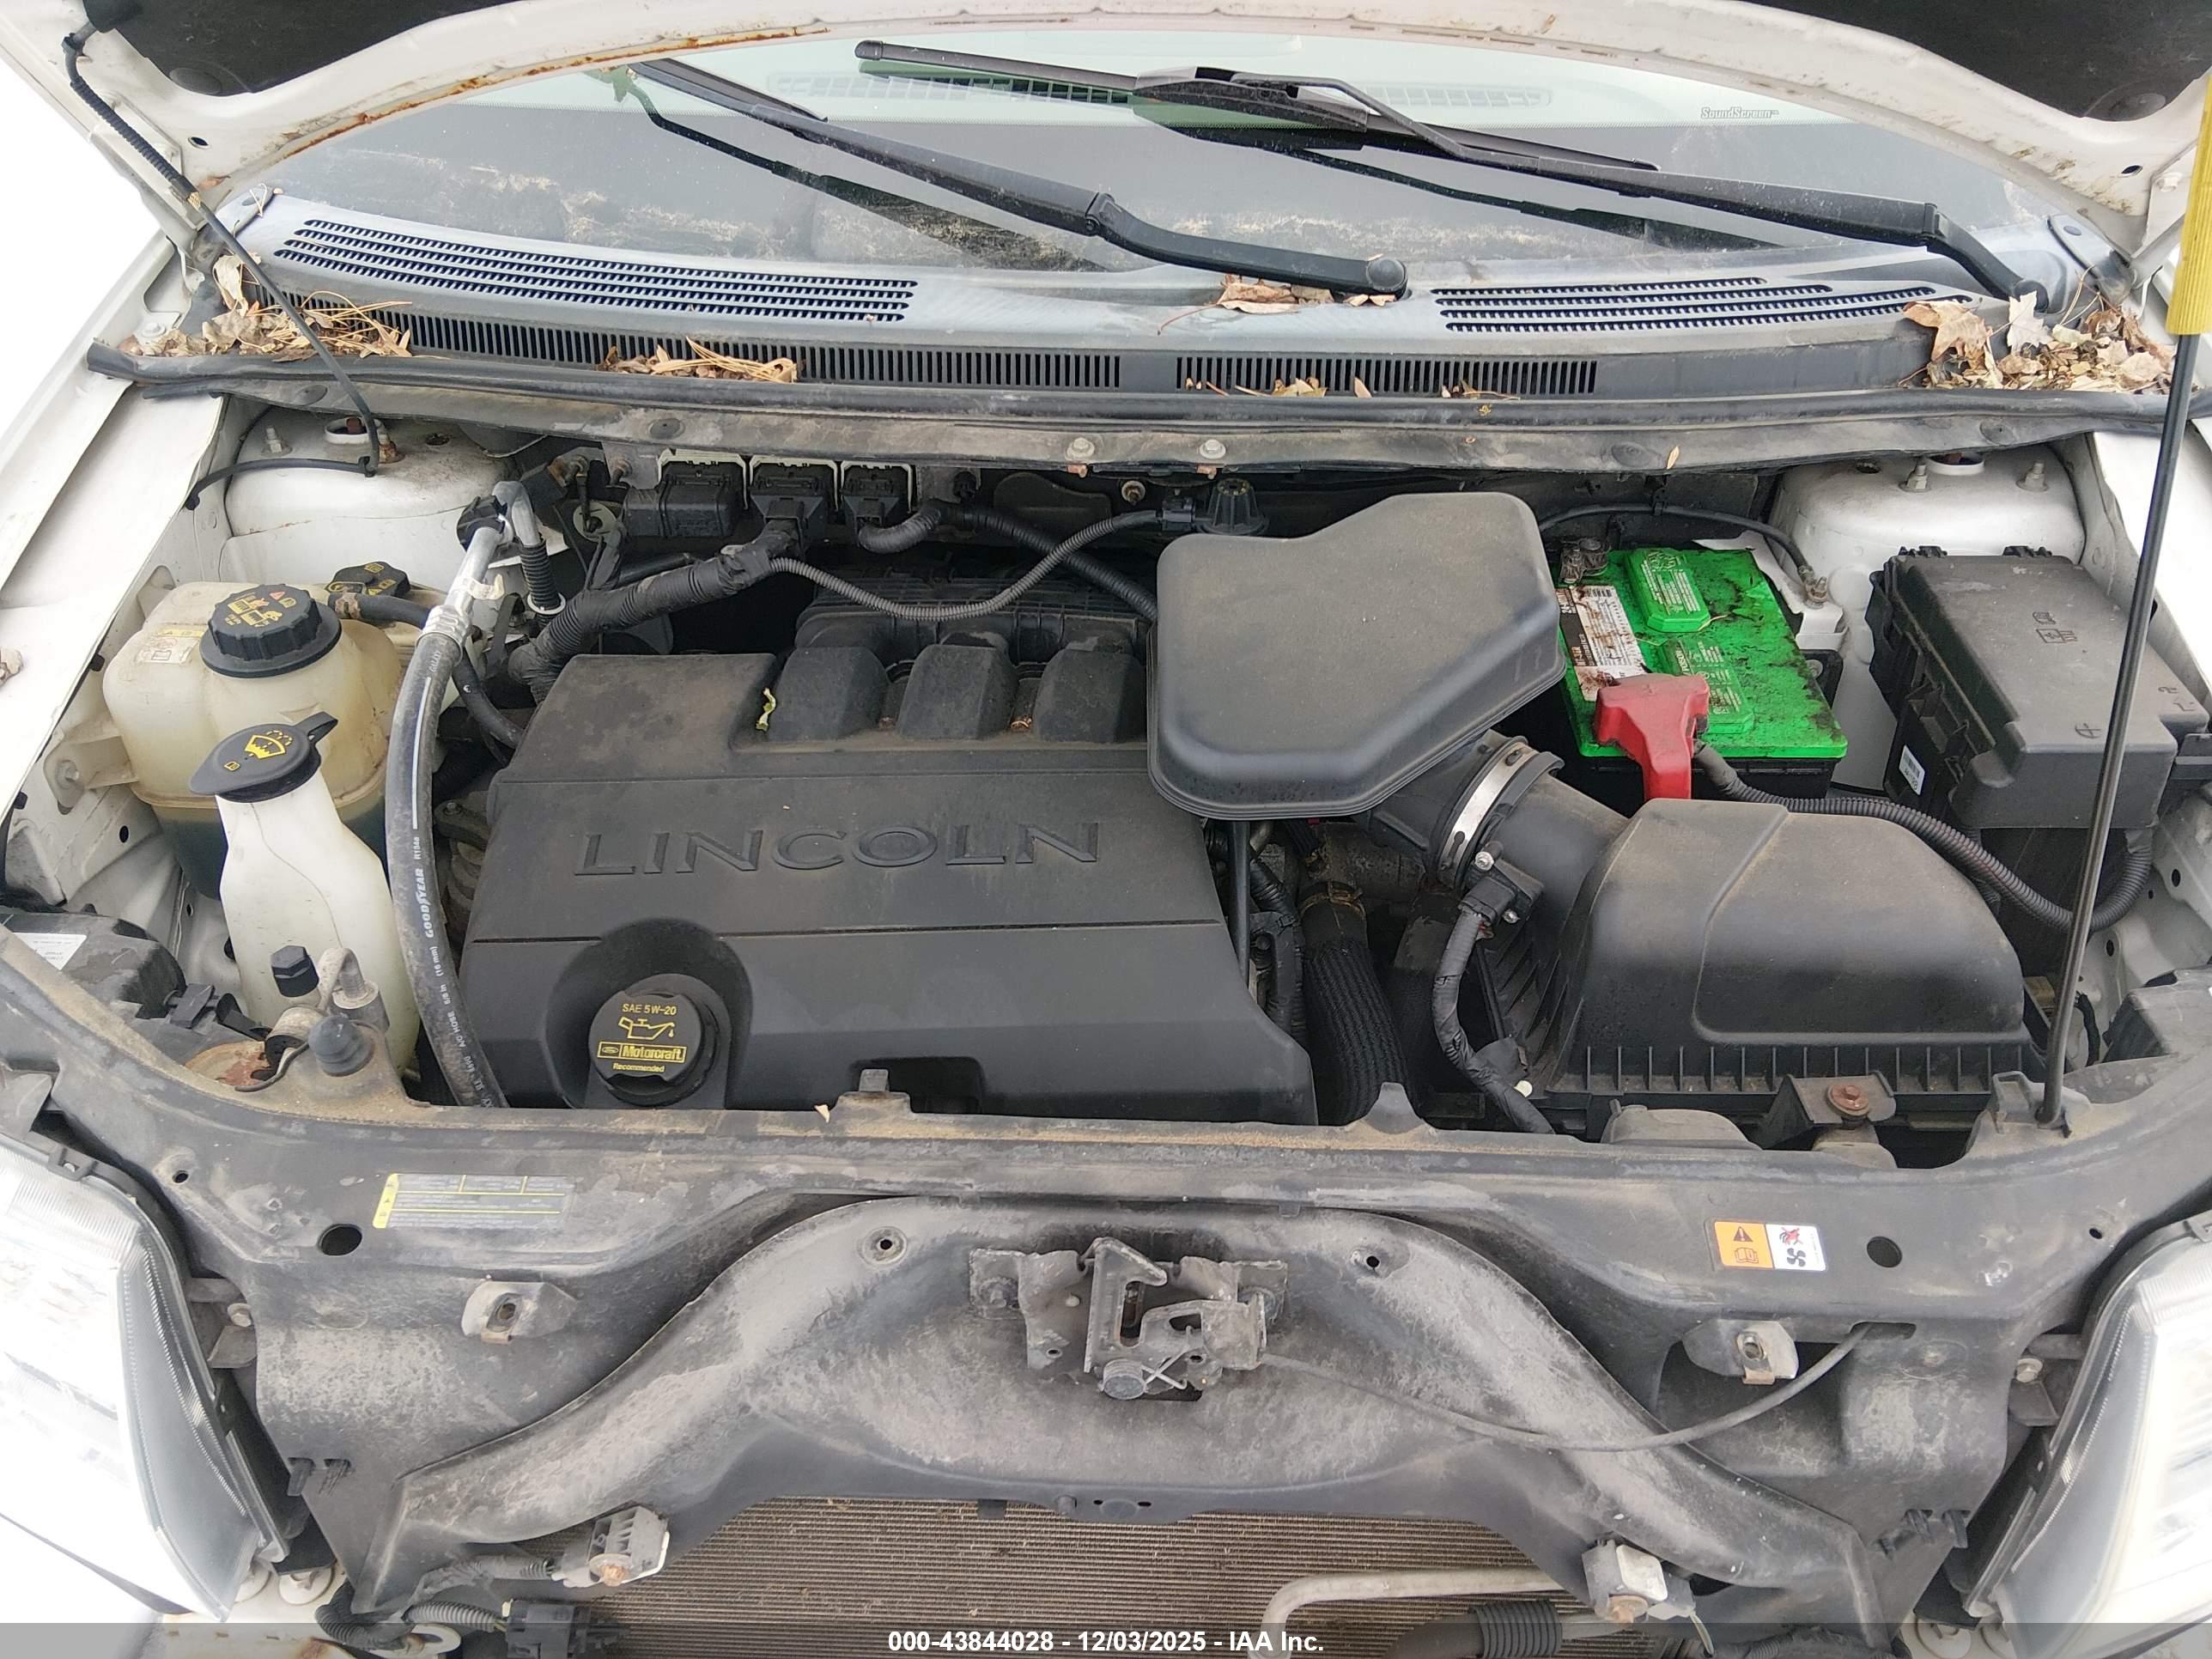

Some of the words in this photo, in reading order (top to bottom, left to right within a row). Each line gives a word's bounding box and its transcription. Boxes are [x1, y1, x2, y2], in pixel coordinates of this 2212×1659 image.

[1700, 106, 1773, 118] SoundScreen
[574, 823, 1098, 876] LINCOLN
[416, 868, 434, 938] GOODYEAR
[622, 1003, 642, 1013] SAE
[644, 1005, 677, 1015] 5W-20
[623, 1045, 683, 1060] Motorcraft
[612, 1063, 665, 1073] Recommended
